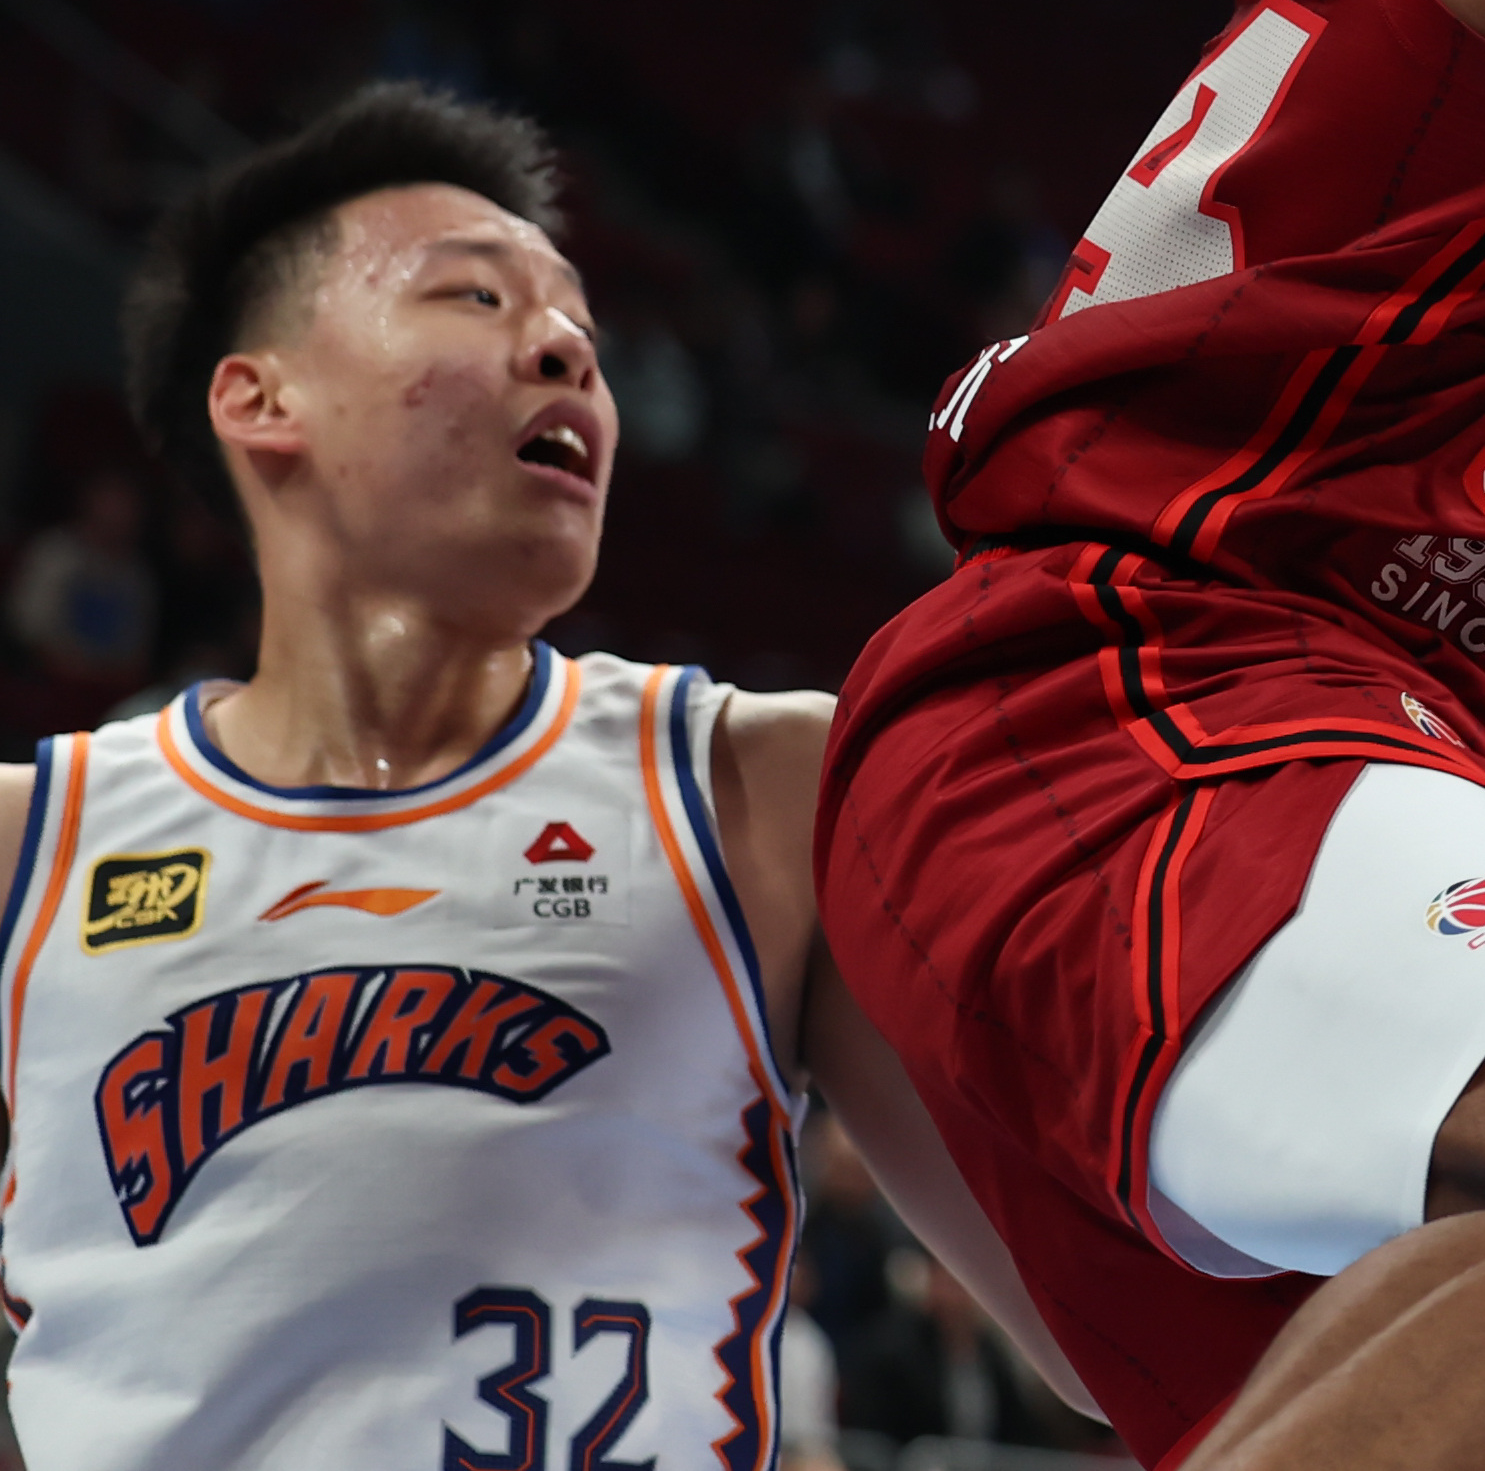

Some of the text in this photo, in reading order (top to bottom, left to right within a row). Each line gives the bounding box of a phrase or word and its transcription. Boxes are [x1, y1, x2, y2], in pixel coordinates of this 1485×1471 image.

[532, 897, 592, 918] CGB
[94, 964, 611, 1248] SHARKS
[441, 1285, 658, 1471] 32
